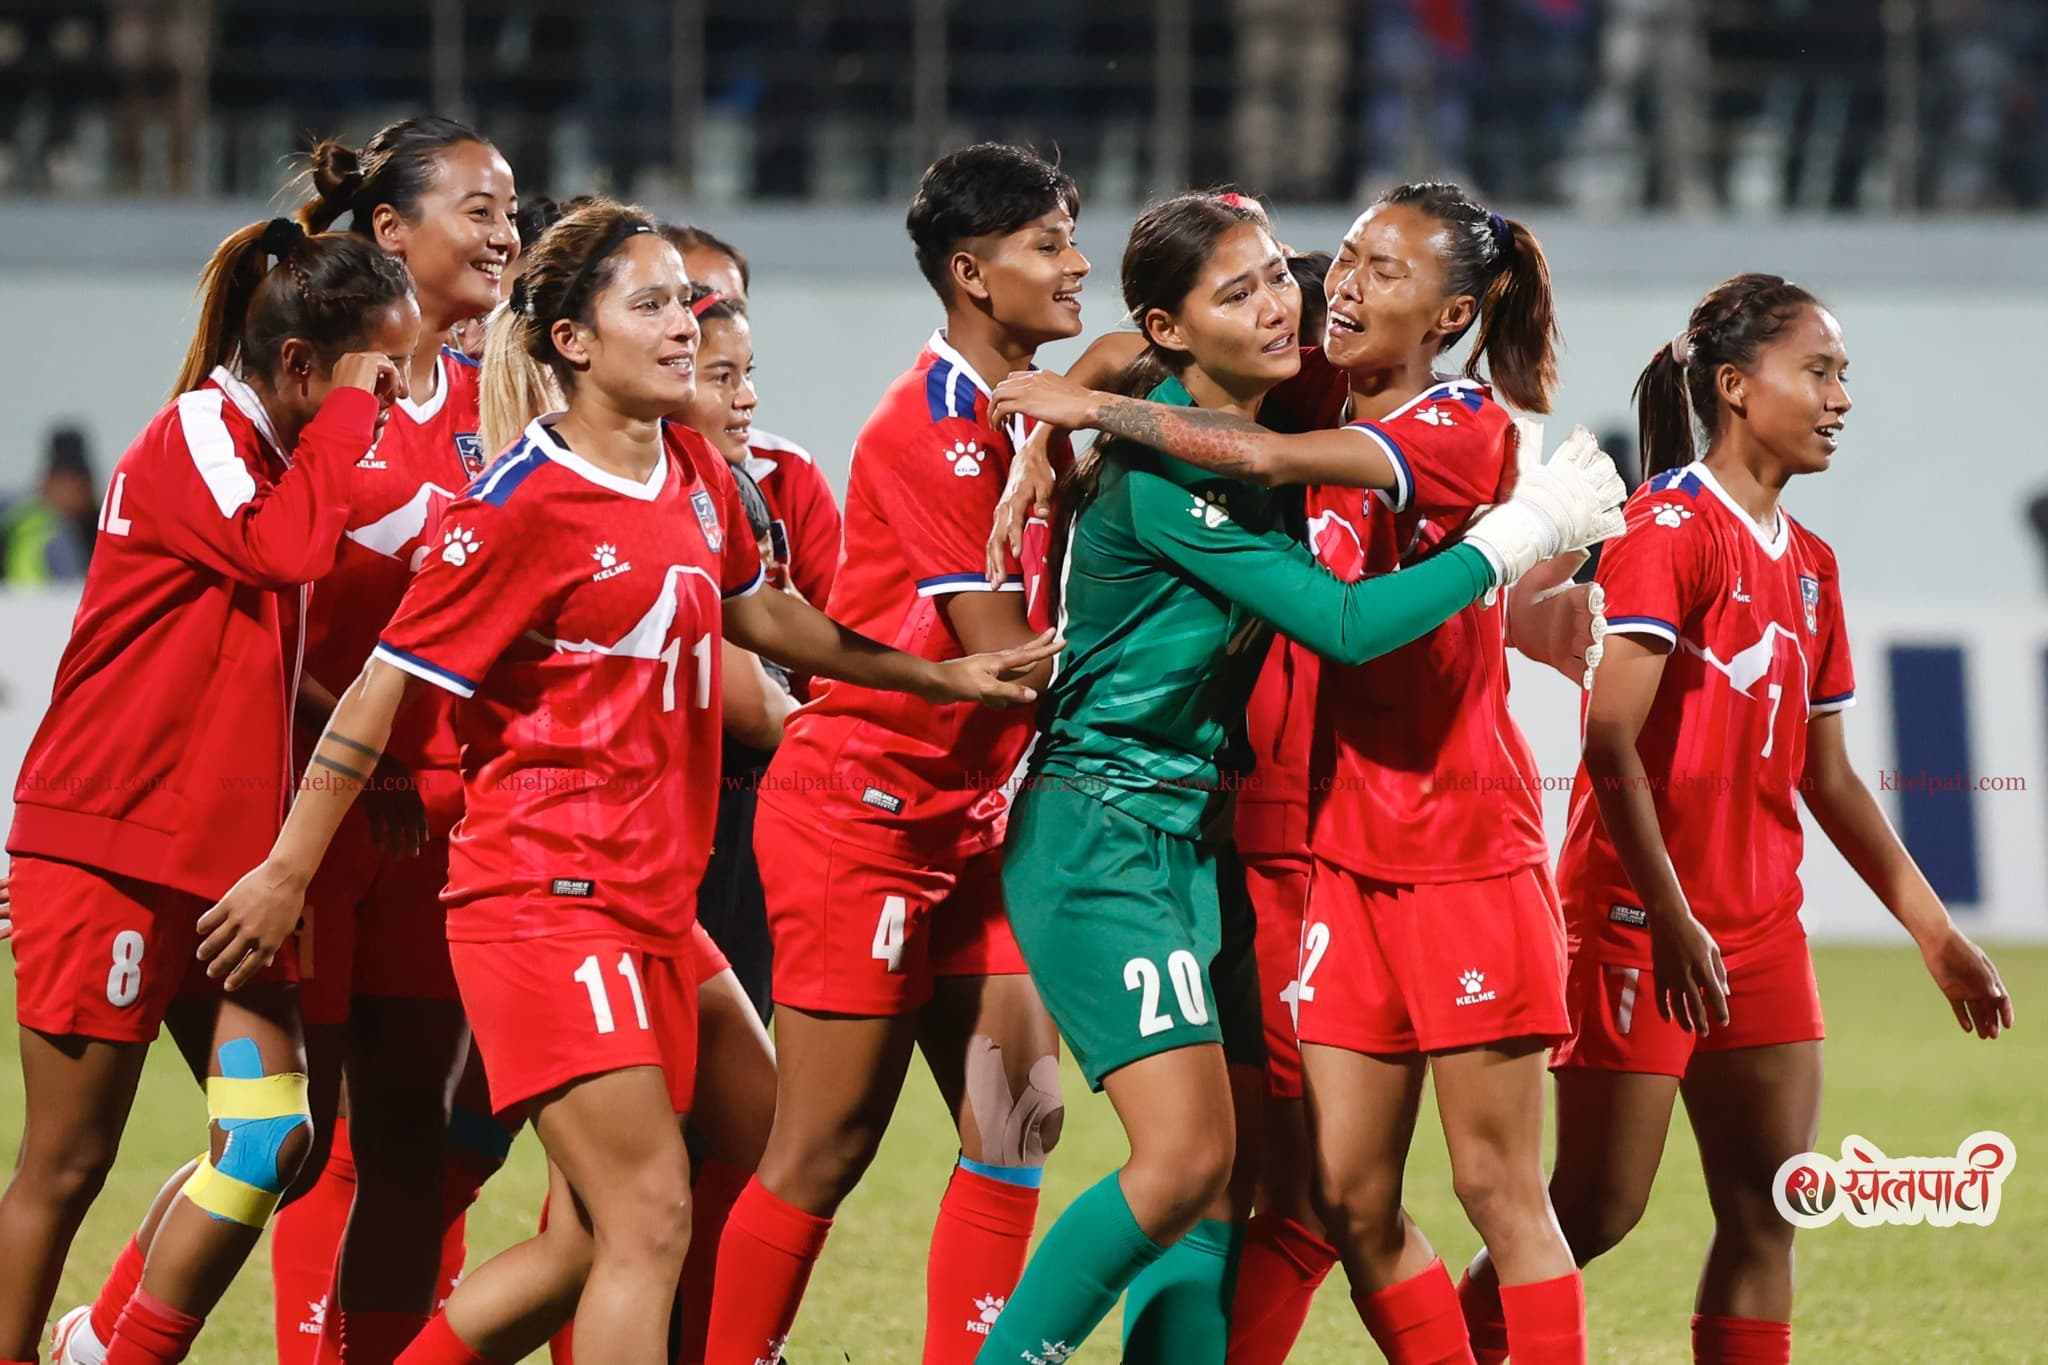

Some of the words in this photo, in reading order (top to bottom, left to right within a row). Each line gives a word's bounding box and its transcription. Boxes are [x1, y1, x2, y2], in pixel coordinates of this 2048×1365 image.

[98, 471, 132, 537] L
[592, 561, 633, 583] KELME
[659, 631, 712, 713] 11
[1760, 683, 1782, 758] 7
[106, 929, 146, 1007] 8
[870, 895, 907, 973] 4
[1298, 920, 1331, 1002] 2
[573, 952, 649, 1035] 11
[1123, 949, 1210, 1038] 20
[1455, 990, 1497, 1007] KELME
